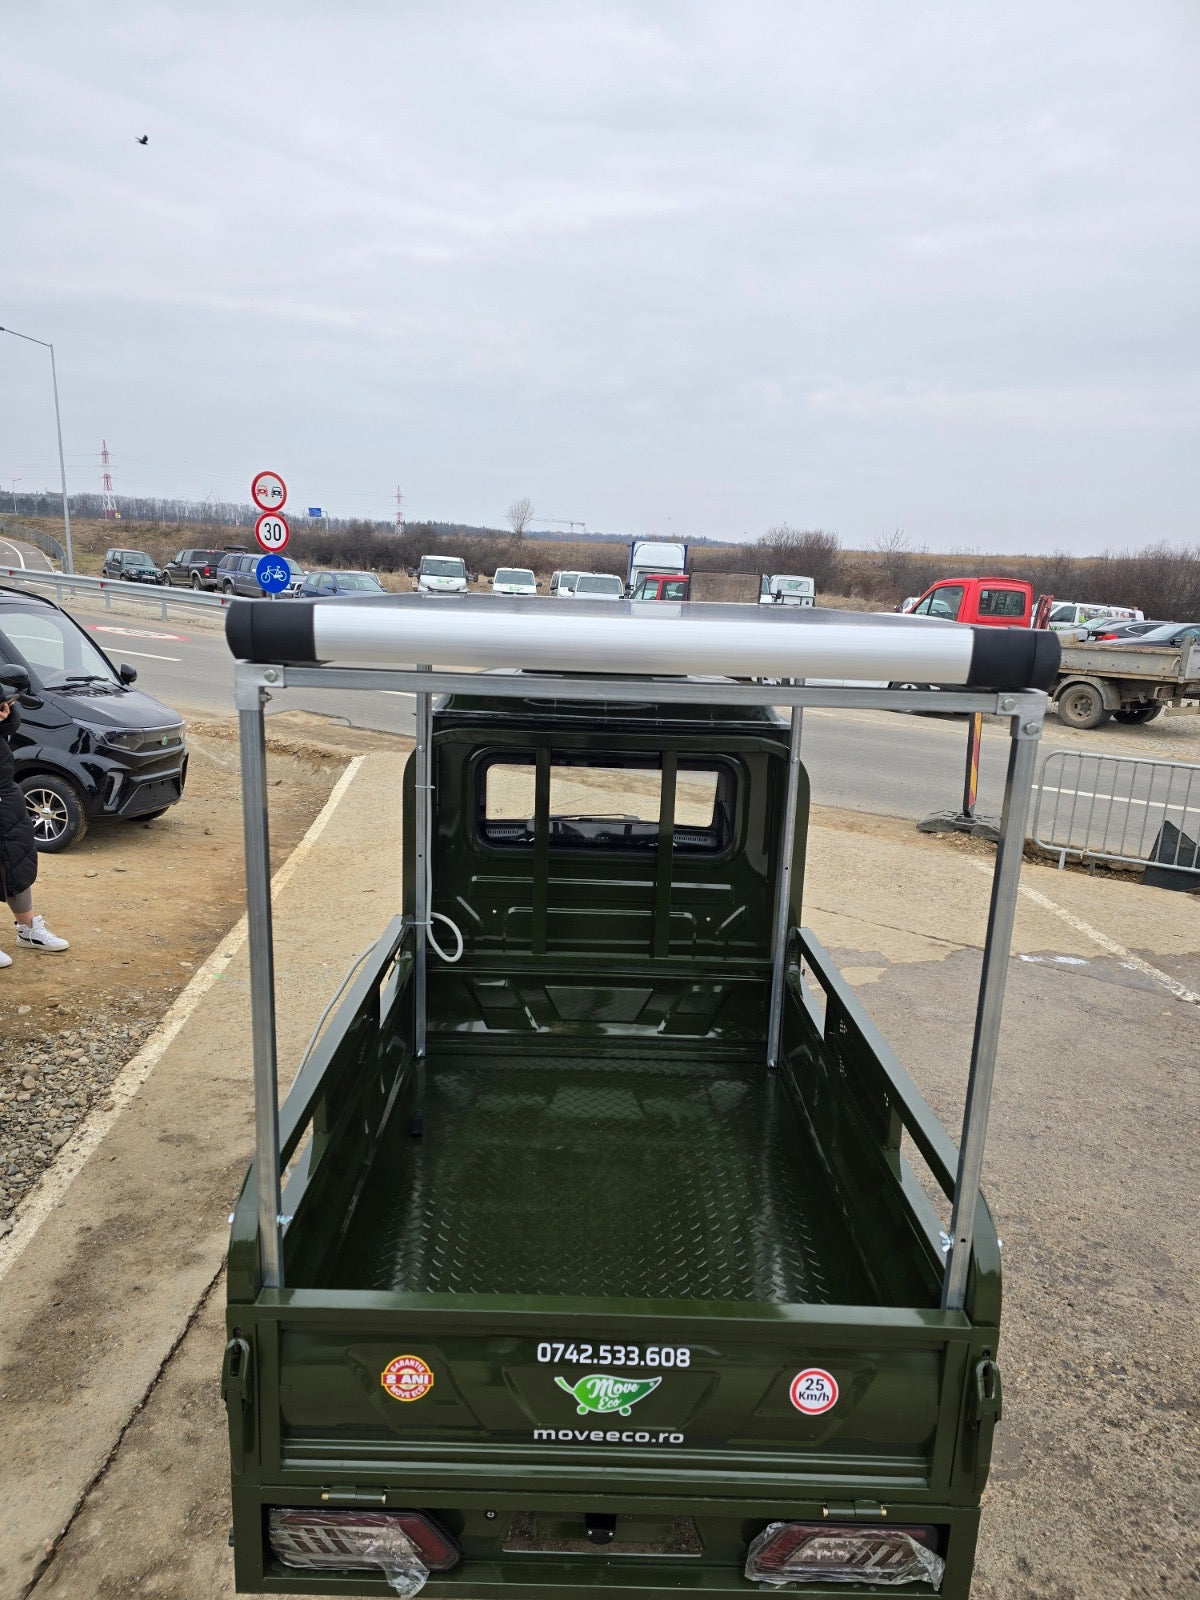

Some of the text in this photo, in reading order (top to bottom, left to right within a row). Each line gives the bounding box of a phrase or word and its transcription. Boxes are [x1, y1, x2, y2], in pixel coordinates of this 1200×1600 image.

[264, 522, 282, 541] 30
[536, 1342, 691, 1367] 0742.533.608
[386, 1374, 429, 1384] 2 ANI
[805, 1378, 825, 1391] 25
[586, 1378, 639, 1399] Move
[598, 1396, 623, 1410] Eco
[798, 1391, 830, 1402] Km/h
[533, 1429, 684, 1443] moveeco.ro
